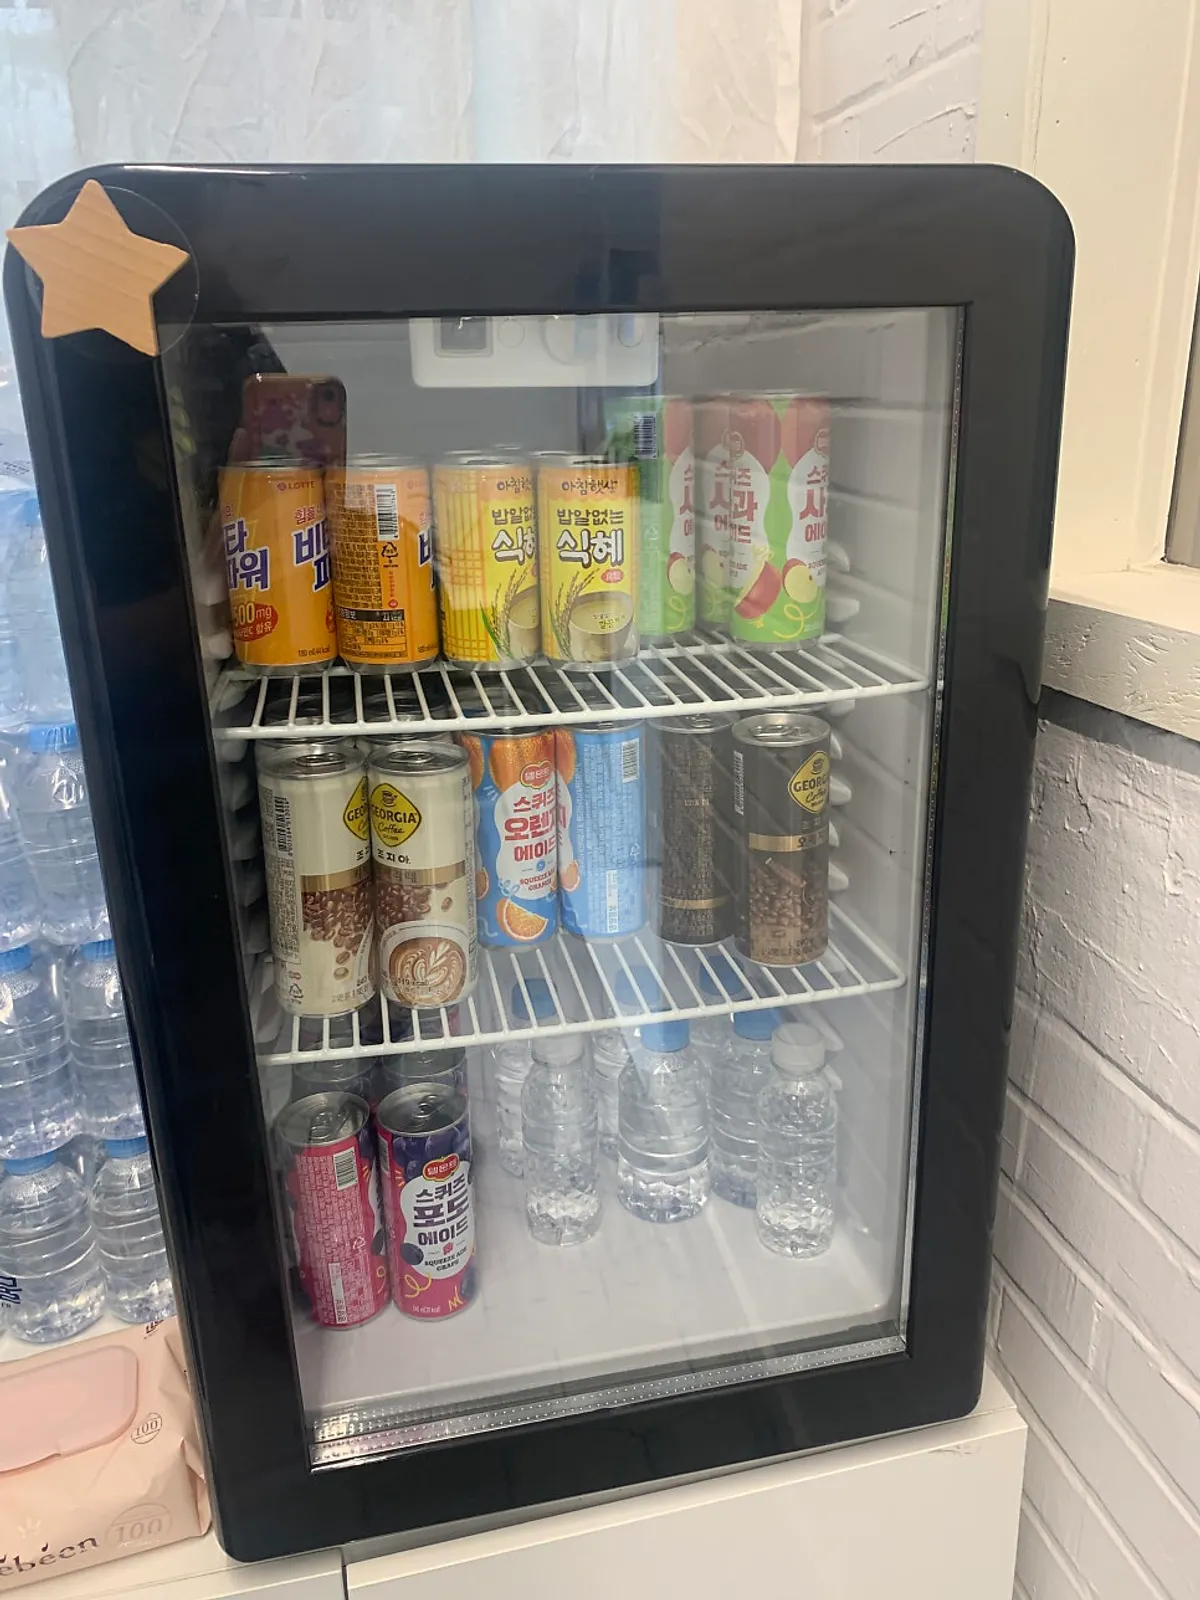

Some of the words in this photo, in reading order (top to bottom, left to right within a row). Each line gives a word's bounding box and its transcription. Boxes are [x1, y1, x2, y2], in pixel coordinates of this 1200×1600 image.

[288, 480, 317, 490] LOTTE
[561, 476, 619, 495] 아침햇살
[556, 506, 624, 527] 밥알없는
[555, 526, 625, 569] 식혜
[415, 1172, 467, 1203] 스퀴즈
[413, 1193, 470, 1228] 포도
[417, 1215, 470, 1246] 에이드
[135, 1419, 158, 1437] 100
